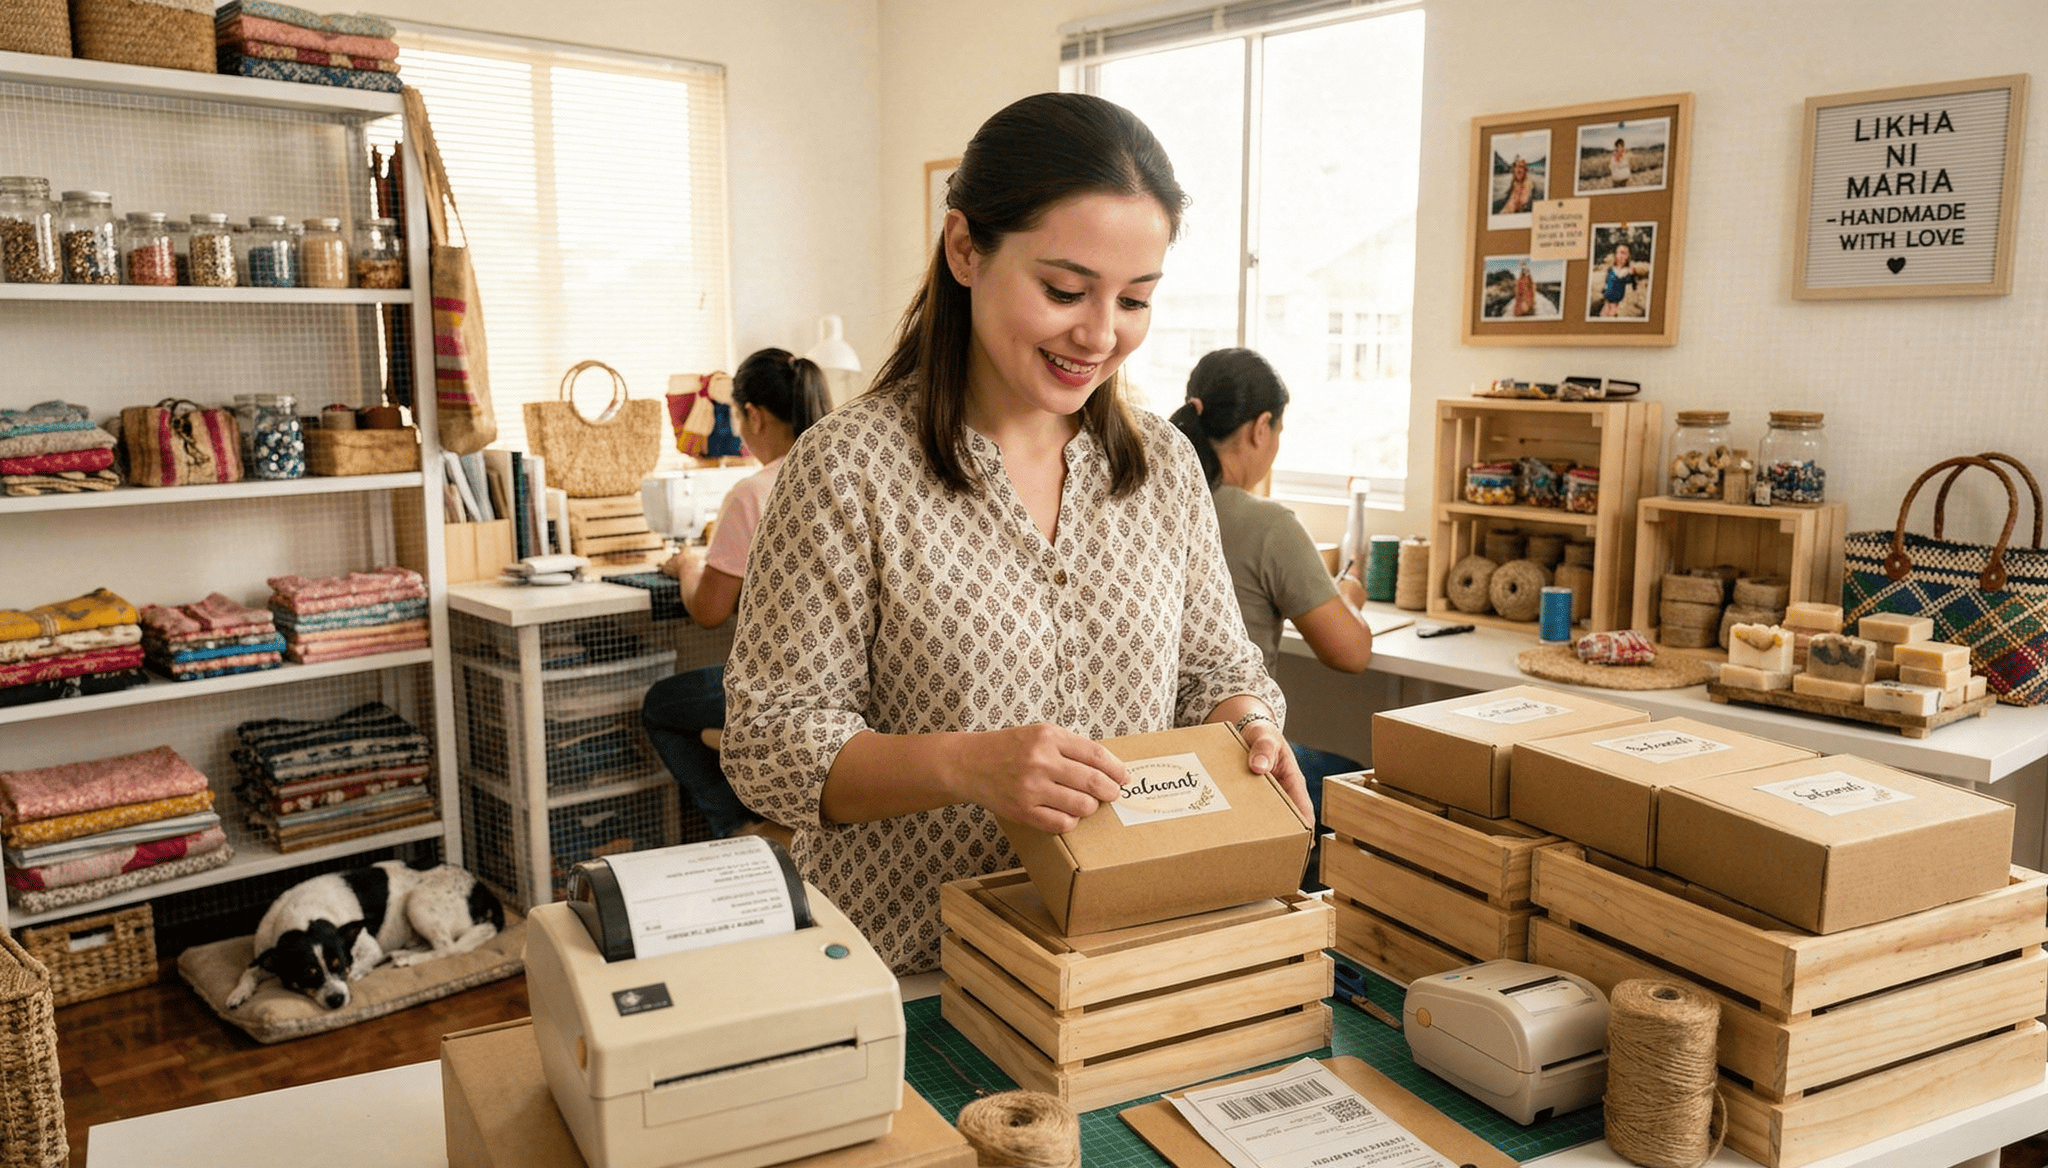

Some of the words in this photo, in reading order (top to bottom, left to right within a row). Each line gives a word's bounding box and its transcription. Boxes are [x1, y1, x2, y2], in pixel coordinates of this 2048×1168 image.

[1855, 110, 1955, 142] LIKHA
[1886, 143, 1917, 169] NI
[1847, 168, 1954, 199] MARIA
[1839, 231, 1896, 250] WITH
[1906, 228, 1965, 248] LOVE
